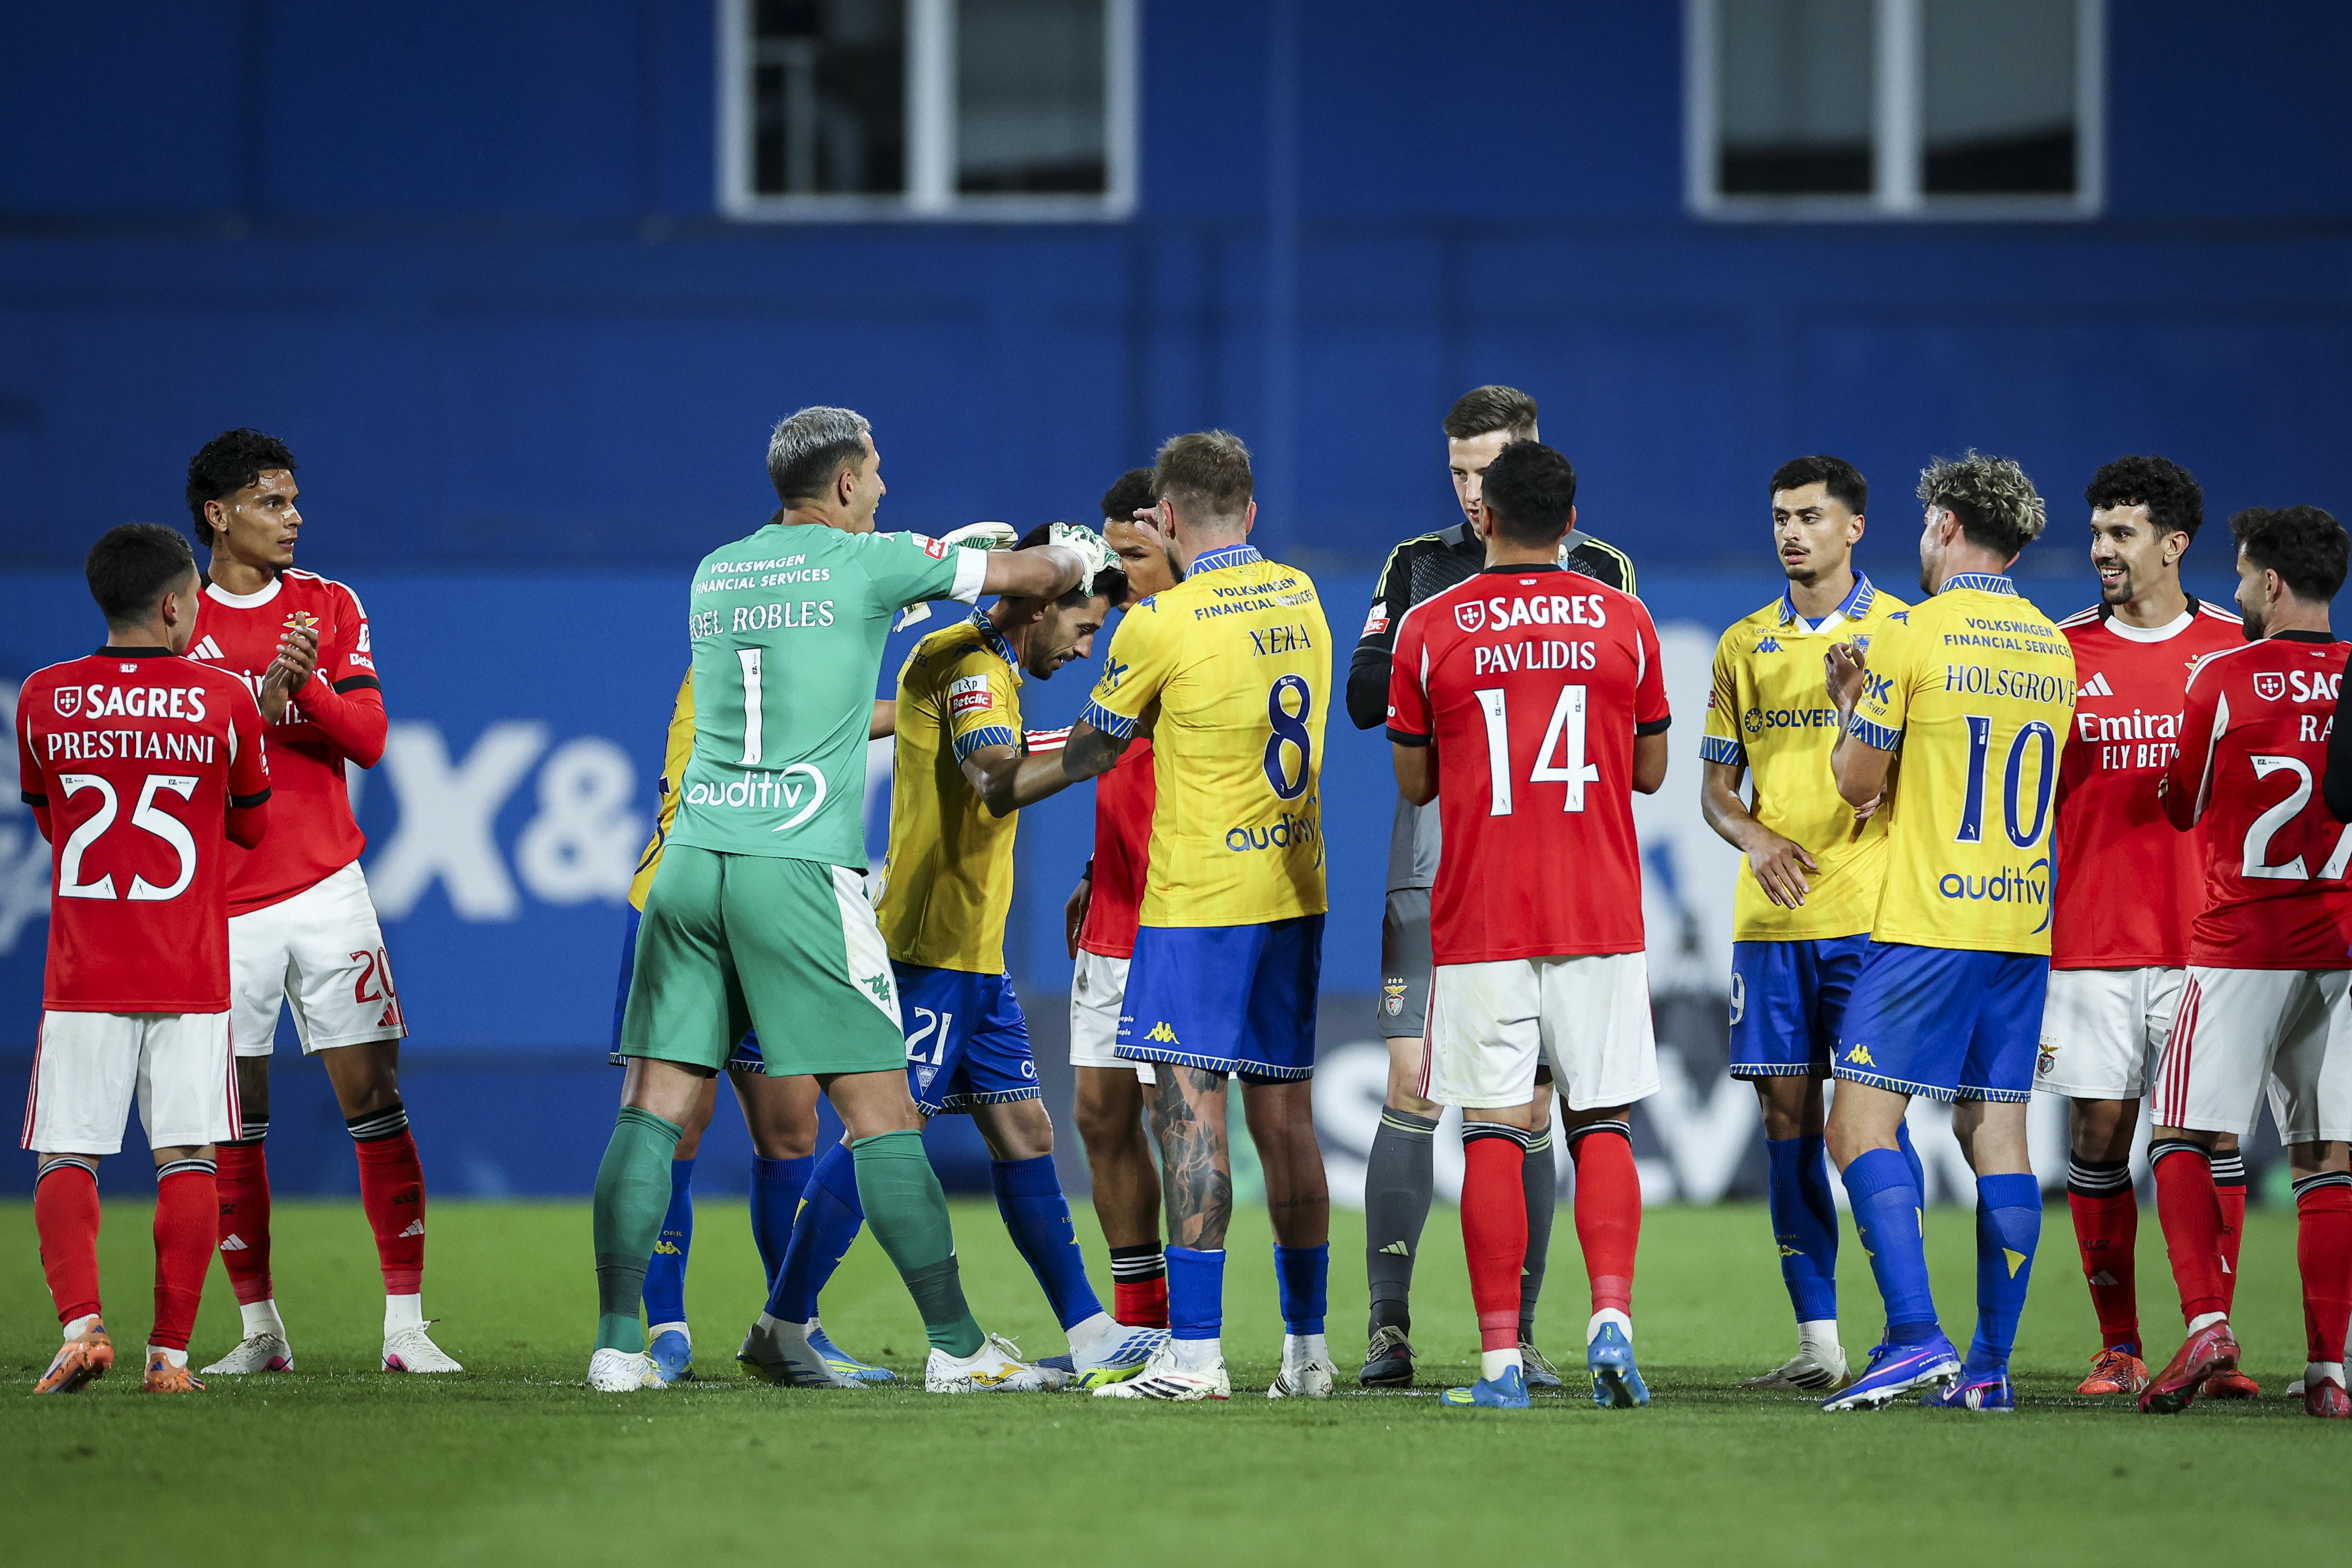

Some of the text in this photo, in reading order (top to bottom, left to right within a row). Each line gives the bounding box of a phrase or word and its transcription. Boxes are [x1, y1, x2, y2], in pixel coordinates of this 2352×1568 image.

[711, 553, 806, 574] VOLKSWAGEN
[695, 568, 830, 596] FINANCIAL SERVICES
[1212, 577, 1297, 597] VOLKSWAGEN
[732, 600, 834, 632] ROBLES
[1194, 598, 1276, 621] FINANCIAL
[1489, 594, 1606, 631] SAGRES
[1965, 618, 2053, 637] VOLKSWAGEN
[1475, 640, 1597, 675] PAVLIDIS
[1944, 634, 2022, 650] FINANCIAL
[85, 683, 206, 723] SAGRES
[952, 693, 989, 710] Betclic
[1945, 665, 2076, 708] HOLSGROVE
[735, 647, 763, 766] 1
[1766, 709, 1842, 728] SOLVER
[47, 729, 214, 764] PRESTIANNI
[1262, 673, 1312, 801] 8
[1474, 684, 1601, 817] 14
[2102, 745, 2131, 770] FLY
[686, 770, 803, 808] auditiv
[1954, 714, 2057, 850] 10
[58, 773, 200, 901] 25
[1939, 865, 2046, 905] auditiv
[349, 946, 395, 1004] 20
[904, 1006, 953, 1066] 21
